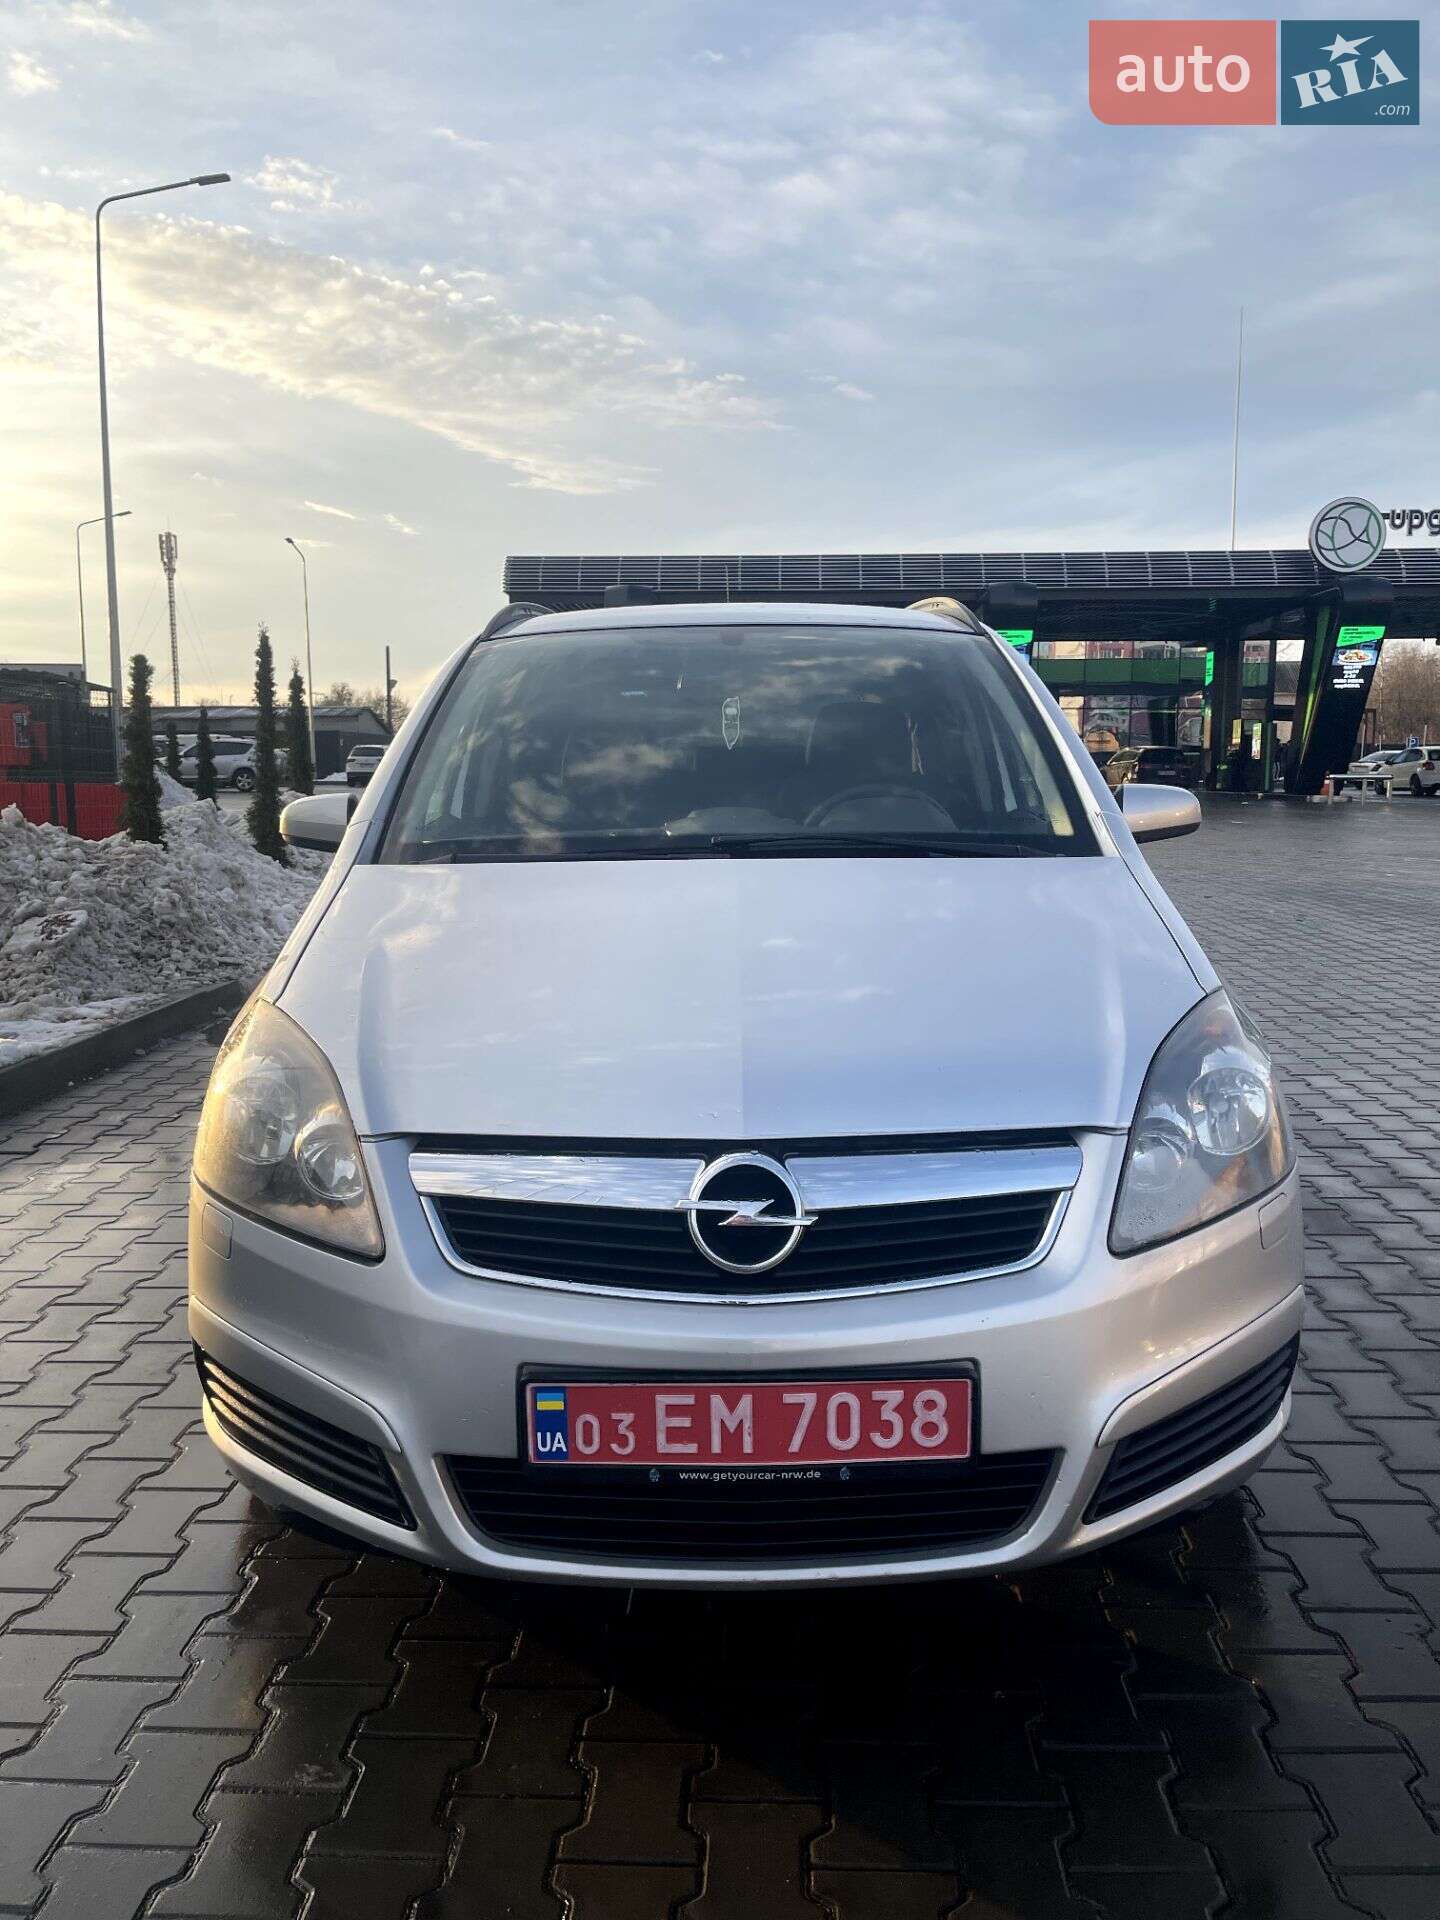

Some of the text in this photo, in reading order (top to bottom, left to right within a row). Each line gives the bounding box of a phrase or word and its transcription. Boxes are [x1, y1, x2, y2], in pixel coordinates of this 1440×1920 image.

[575, 1389, 949, 1455] 03 EM 7038
[537, 1432, 567, 1453] UA
[679, 1469, 822, 1482] www.getyourcar-nrw.de
